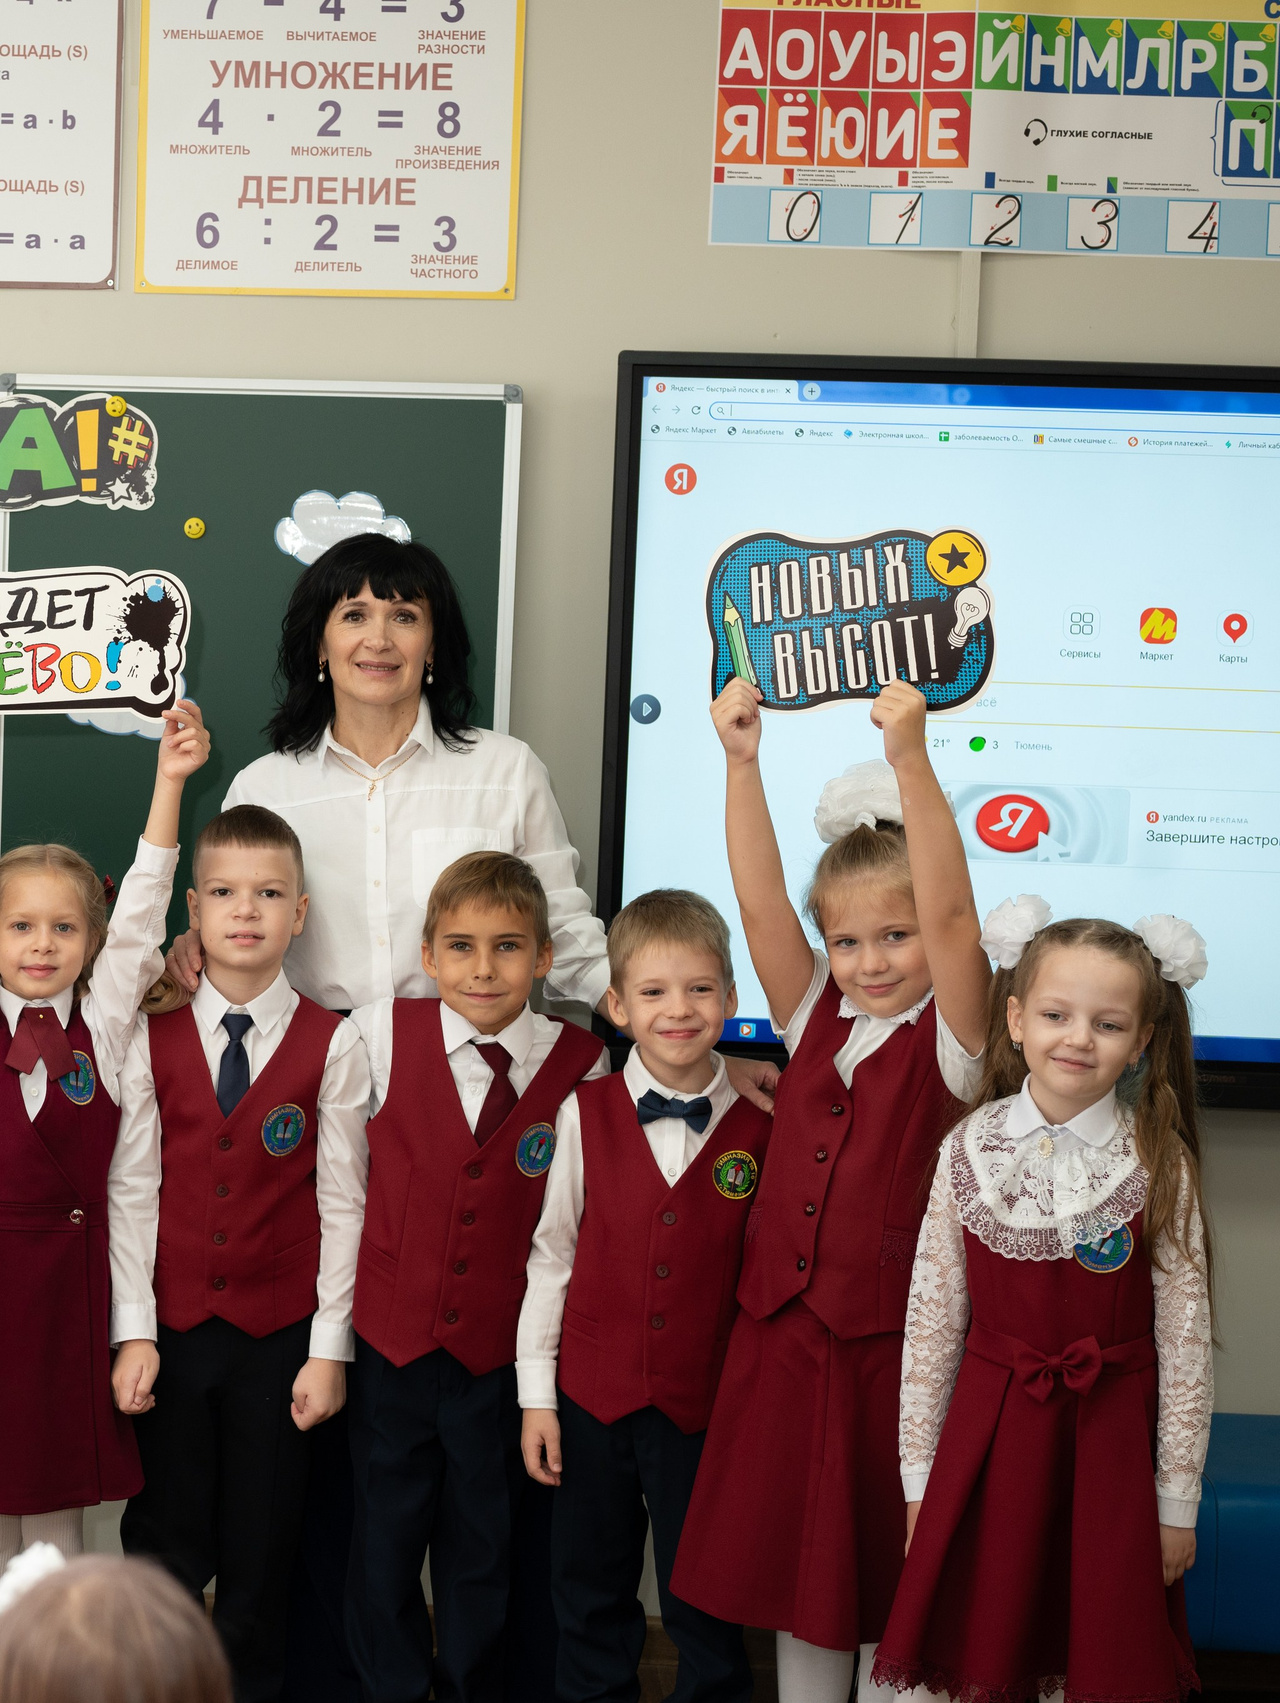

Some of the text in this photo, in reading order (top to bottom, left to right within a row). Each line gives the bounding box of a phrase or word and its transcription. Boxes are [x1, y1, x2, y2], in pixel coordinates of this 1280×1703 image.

[440, 0, 466, 24] 3
[162, 30, 486, 42] УМЕНЬШАЕМОЕ ВЫЧИТАЕМОЕ ЗНАЧЕНИЕ
[67, 45, 89, 61] (S)
[417, 44, 486, 55] РАЗНОСТИ
[723, 18, 1268, 92] А О У Ы Э Й Н М Л Р Б
[210, 60, 454, 91] УМНОЖЕНИЕ
[197, 98, 462, 139] 4 2 8
[721, 92, 1267, 171] Я Ё Ю И Е П
[1050, 129, 1153, 140] ГЛУХИЕ СОГЛАСНЫЕ
[169, 145, 482, 157] МНОЖИТЕЛЬ МНОЖИТЕЛЬ ЗНАЧЕНИЕ
[395, 159, 500, 172] ПРОИЗВЕДЕНИЯ
[64, 180, 85, 197] (S)
[237, 176, 417, 210] ДЕЛЕНИЕ
[786, 192, 1219, 253] 0 1 2 3 4
[195, 211, 458, 254] 6 2 3
[175, 254, 479, 273] ДЕЛИМОЕ ДЕЛИТЕЛЬ ЗНАЧЕНИЕ
[410, 268, 479, 280] ЧАСТНОГО
[670, 384, 695, 393] Яндекс
[665, 426, 717, 436] Яндекс Маркет
[741, 427, 784, 436] Авиабилеты
[809, 429, 834, 438] Яндекс
[858, 430, 904, 440] Электронная
[954, 433, 1011, 442] заболеваемость
[1048, 435, 1107, 445] Самые смешные
[1143, 438, 1173, 448] История
[1238, 440, 1267, 449] Личный
[749, 544, 912, 625] НОВЫХ
[773, 612, 942, 702] ВЫСОТ!
[1059, 648, 1248, 665] Сервисы Маркет Карты
[992, 740, 999, 749] 3
[1014, 740, 1053, 752] Тюмень
[1209, 816, 1249, 824] РЕКЛАМА
[1146, 829, 1280, 849] Завершите настро
[716, 1153, 750, 1169] ГИМНАЗИЯ
